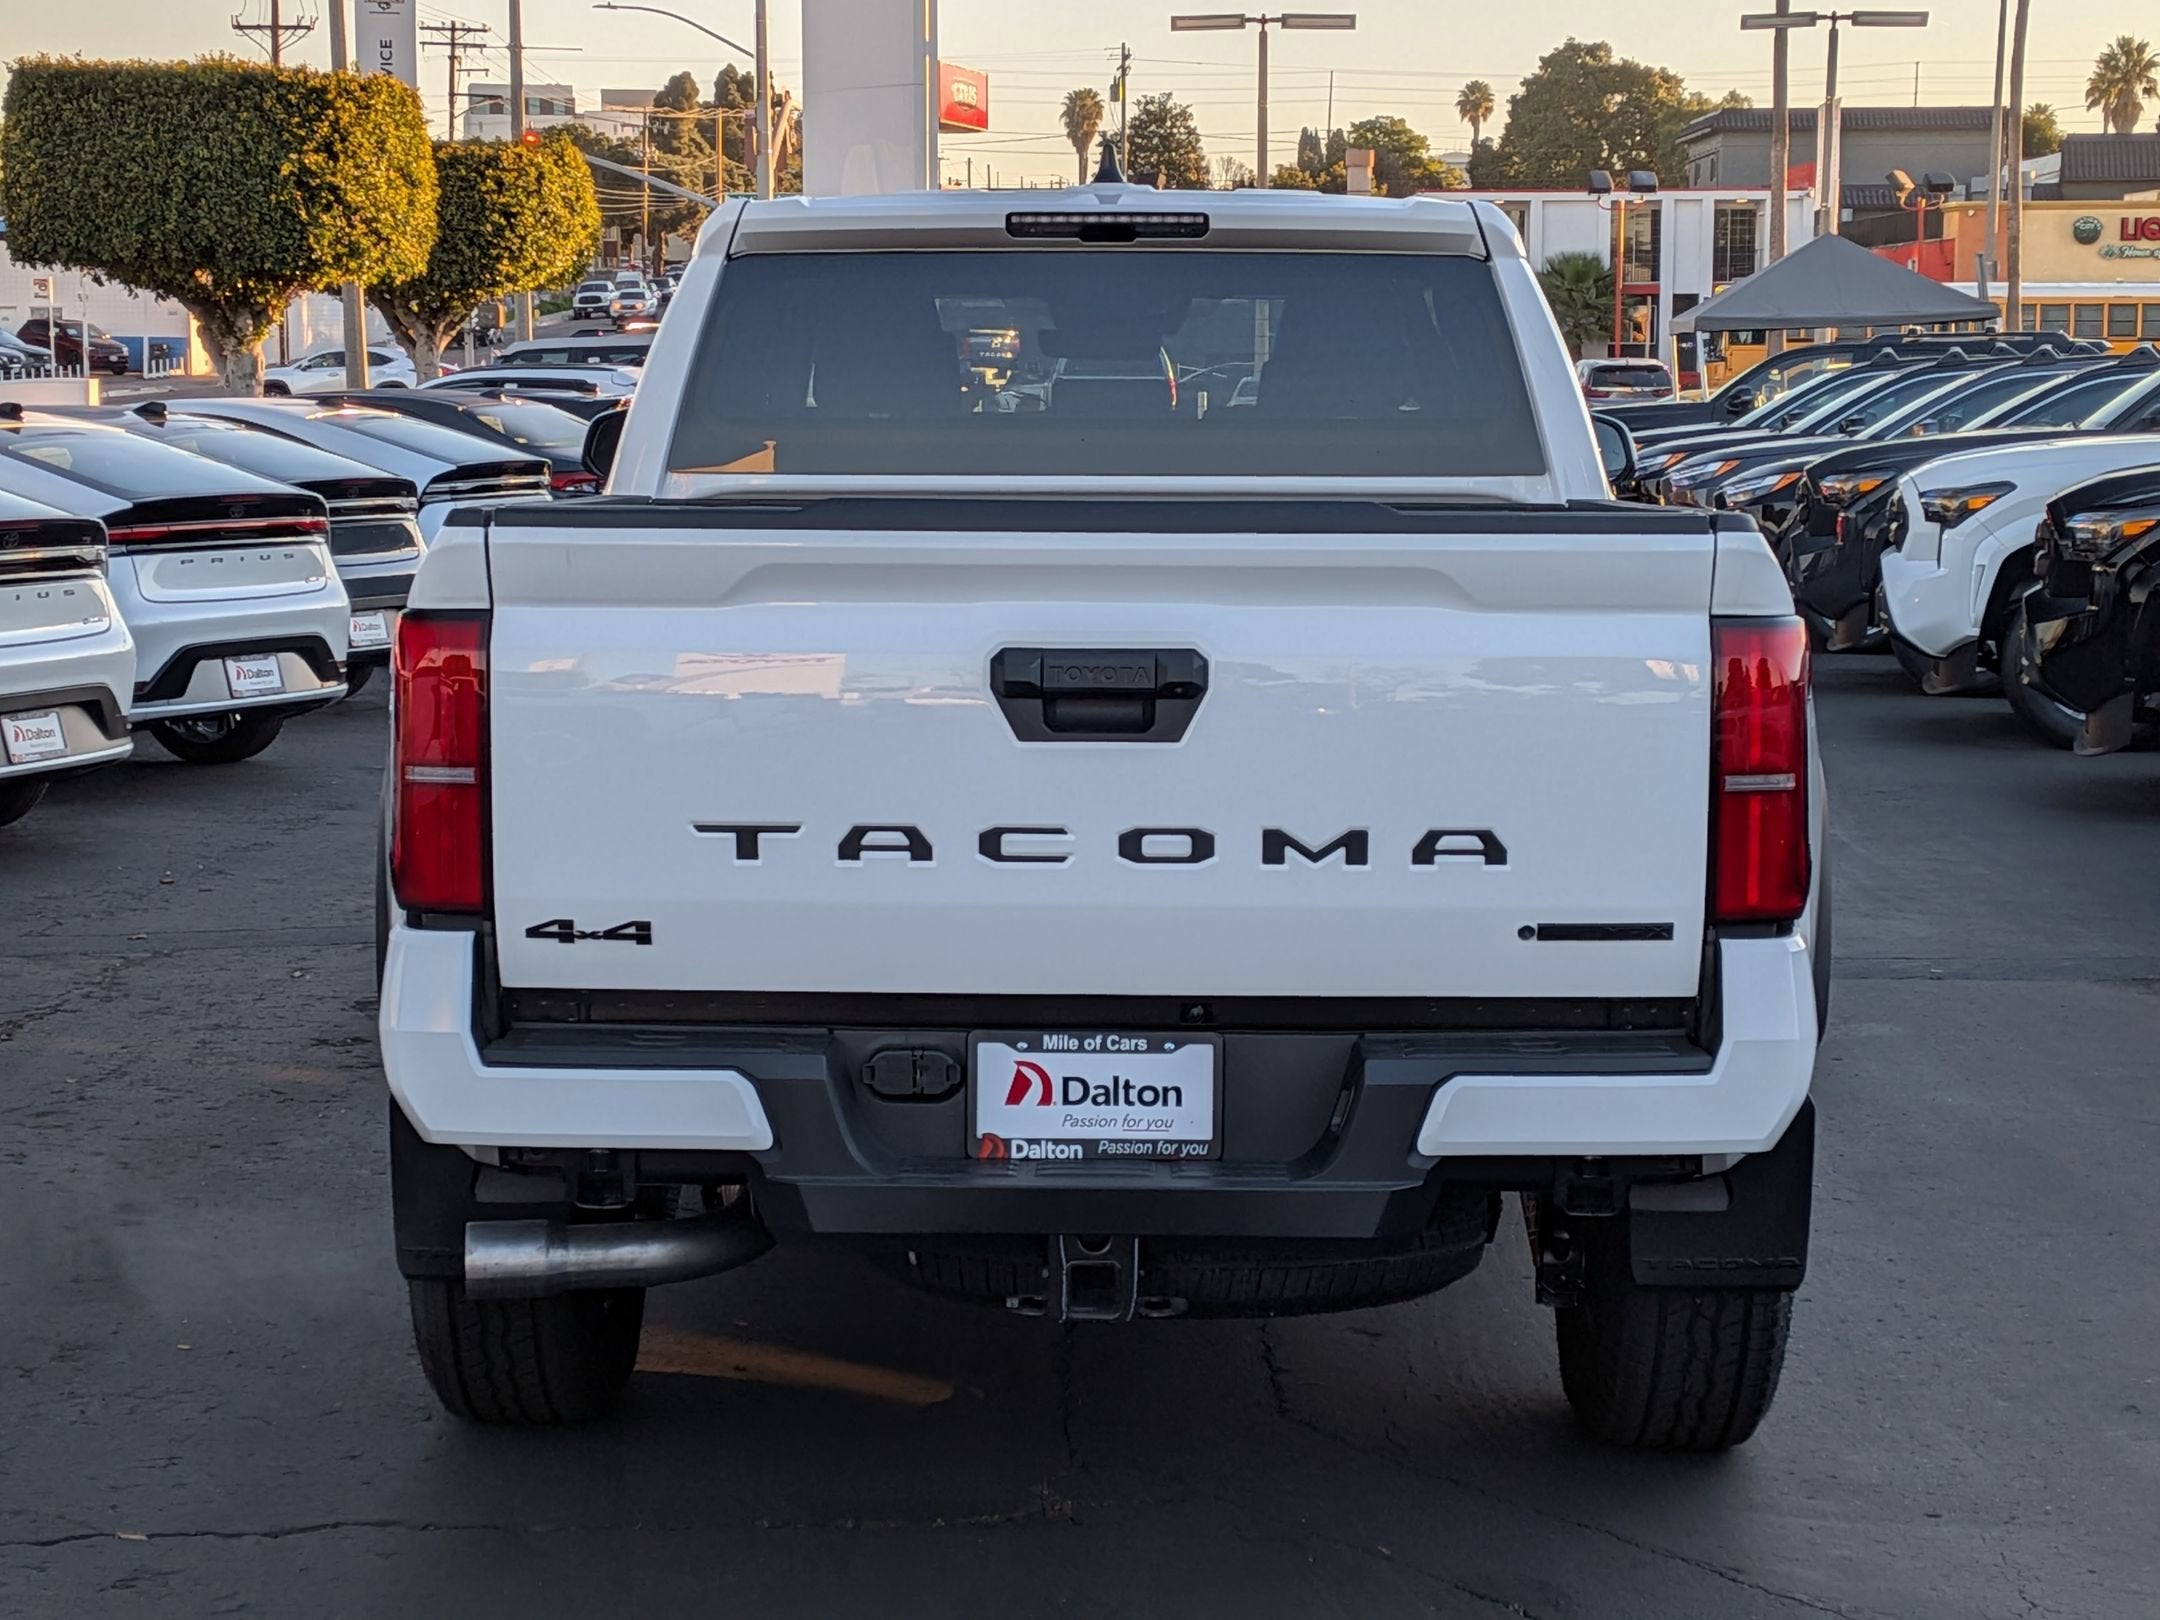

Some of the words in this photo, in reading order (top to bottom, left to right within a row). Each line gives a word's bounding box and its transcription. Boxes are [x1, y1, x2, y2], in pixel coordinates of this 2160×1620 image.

[180, 553, 295, 565] PRIUS
[246, 668, 275, 680] Dalton
[1048, 666, 1150, 683] TOYOTA
[25, 727, 57, 741] Dalton
[693, 824, 1508, 866] TACOMA
[525, 919, 652, 946] 4x4
[1042, 1034, 1079, 1051] Mile
[1083, 1034, 1103, 1051] of
[1106, 1034, 1148, 1051] Cars
[1062, 1075, 1182, 1107] Dalton
[1061, 1113, 1118, 1128] Passion
[1121, 1113, 1143, 1129] for
[1145, 1117, 1174, 1131] you
[1010, 1139, 1084, 1159] Dalton
[1098, 1140, 1152, 1154] Passion
[1156, 1140, 1179, 1156] for
[1180, 1143, 1209, 1158] you
